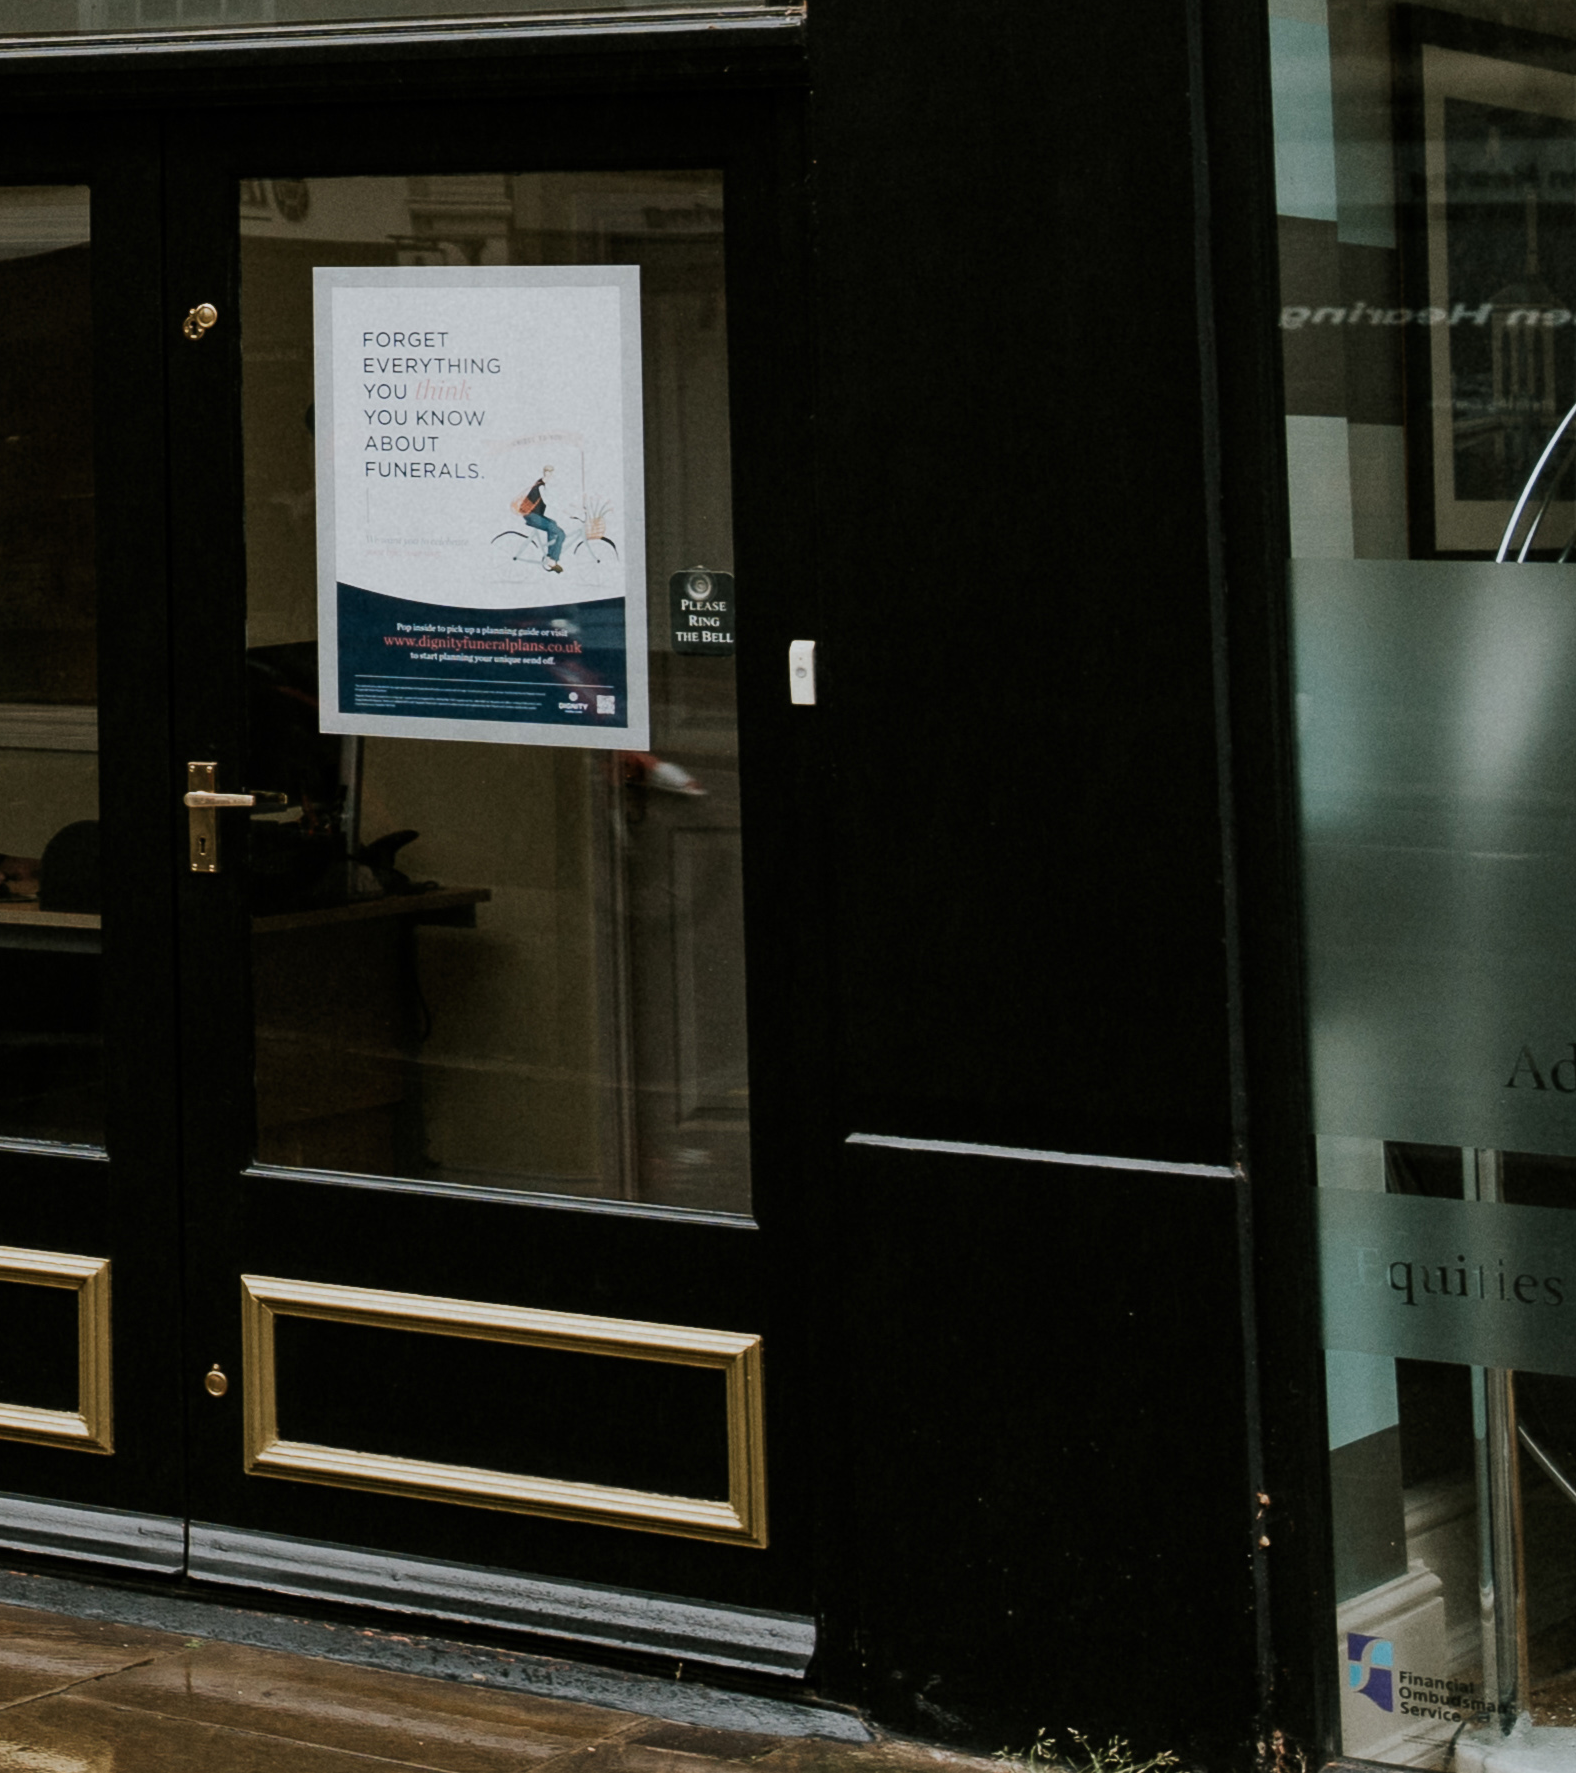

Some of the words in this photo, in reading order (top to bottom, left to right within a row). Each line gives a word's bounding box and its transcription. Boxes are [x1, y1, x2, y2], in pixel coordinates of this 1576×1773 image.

[362, 331, 449, 348] FORGET
[363, 357, 502, 374] EVERYTHING
[363, 384, 408, 401] YOU
[414, 378, 472, 402] think
[364, 410, 408, 426] YOU
[415, 410, 486, 427] KNOW
[364, 436, 440, 453] ABOUT
[364, 462, 485, 480] FUNERALS.
[680, 598, 727, 612] PLEASE
[688, 613, 721, 627] RING
[396, 622, 412, 633] Pop
[413, 623, 436, 633] inside
[437, 624, 445, 633] to
[446, 624, 464, 635] pick
[464, 626, 476, 636] up
[482, 626, 517, 638] planning
[518, 627, 540, 638] guide
[541, 629, 549, 637] or
[550, 627, 568, 637] visit
[675, 630, 703, 644] THE
[705, 630, 734, 644] BELL
[383, 634, 583, 655] www.dignityfuneralplans.co.uk
[410, 652, 418, 660] to
[419, 652, 438, 662] start
[439, 652, 473, 665] planning
[473, 656, 491, 665] your
[493, 655, 521, 666] unique
[522, 655, 541, 665] send
[558, 702, 589, 712] DIGNITY
[1357, 1247, 1564, 1307] Equities
[1399, 1671, 1474, 1695] Financial
[1399, 1686, 1511, 1716] Ombudsman
[1400, 1702, 1462, 1723] Service
